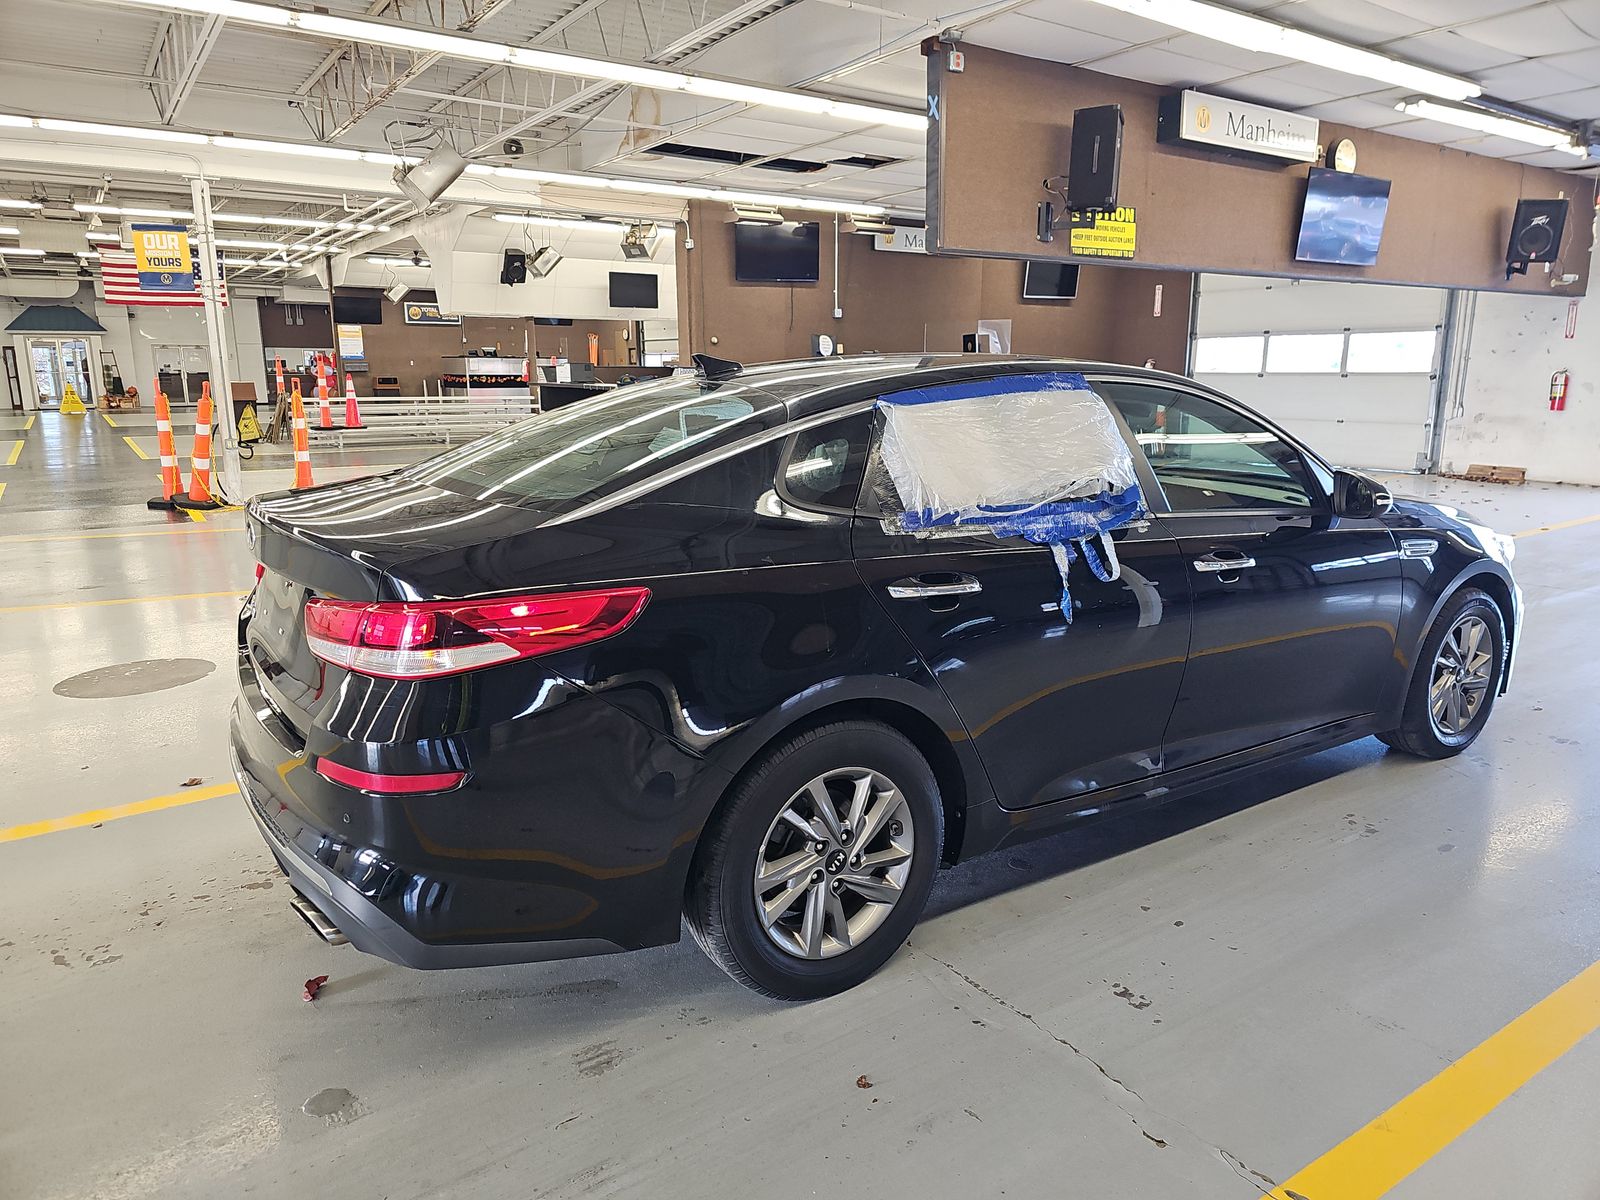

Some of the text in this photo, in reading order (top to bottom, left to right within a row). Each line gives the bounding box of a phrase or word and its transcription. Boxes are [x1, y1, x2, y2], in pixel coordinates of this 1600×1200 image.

[1225, 111, 1306, 146] Manheim
[143, 233, 180, 250] OUR
[1108, 235, 1123, 243] AUCTION
[145, 249, 173, 257] MISSION
[1083, 248, 1097, 256] SAFETY
[146, 257, 182, 267] YOURS
[828, 852, 845, 872] KIA
